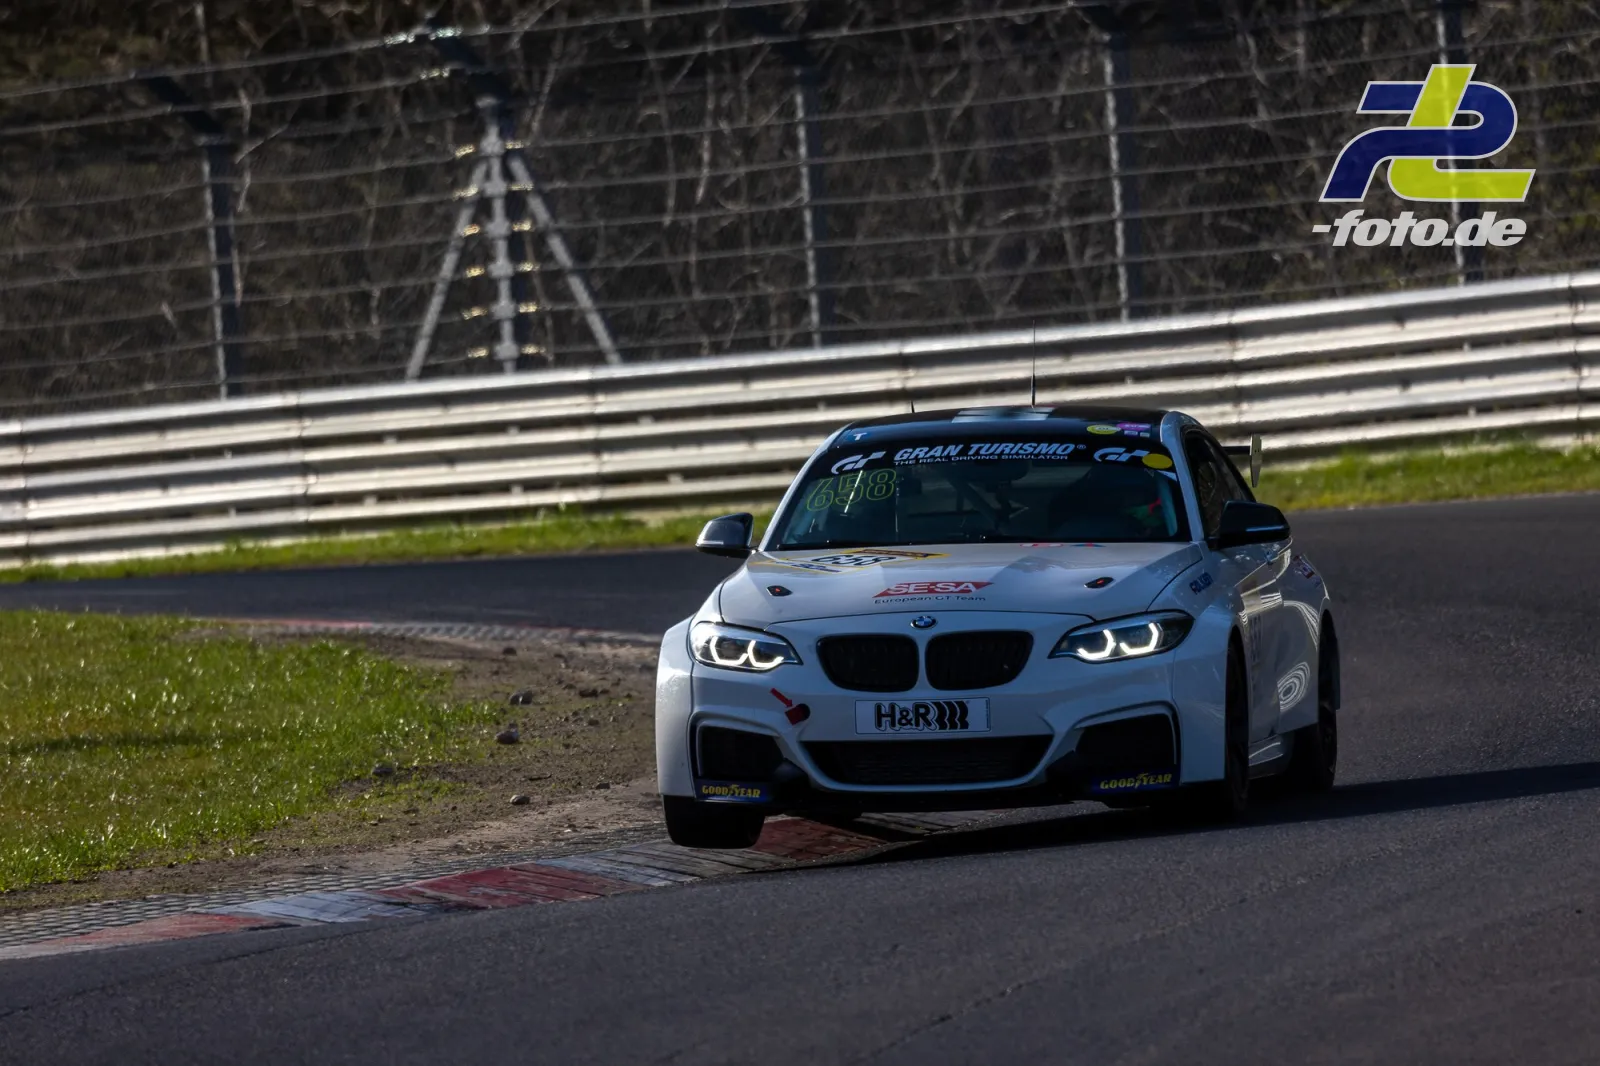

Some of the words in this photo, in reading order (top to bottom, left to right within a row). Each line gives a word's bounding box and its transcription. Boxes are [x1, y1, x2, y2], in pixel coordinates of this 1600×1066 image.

[893, 444, 964, 461] GRAN
[806, 468, 897, 511] 658
[874, 596, 933, 605] European
[874, 702, 938, 732] H&R
